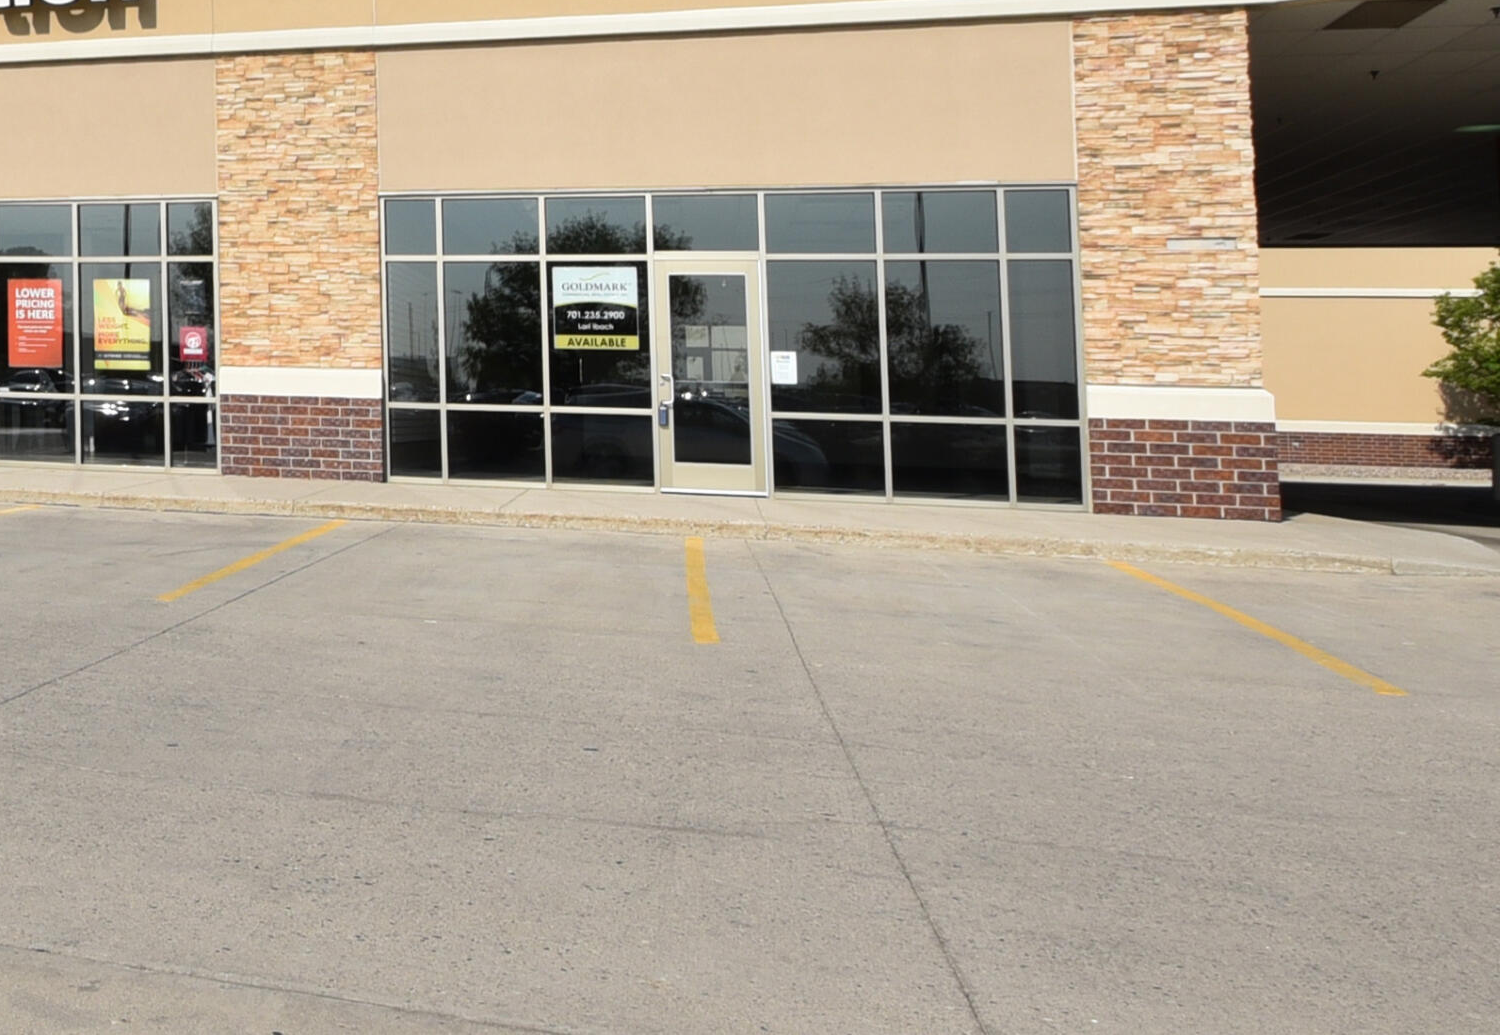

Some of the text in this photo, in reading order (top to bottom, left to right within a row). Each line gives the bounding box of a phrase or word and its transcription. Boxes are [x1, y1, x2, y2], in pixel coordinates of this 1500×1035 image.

[561, 282, 628, 292] GOLDMARK
[15, 288, 55, 298] LOWER
[15, 299, 55, 308] PRICING
[15, 309, 55, 319] IS HERE
[566, 310, 625, 320] 701.235.2900
[566, 337, 627, 347] AVAILABLE
